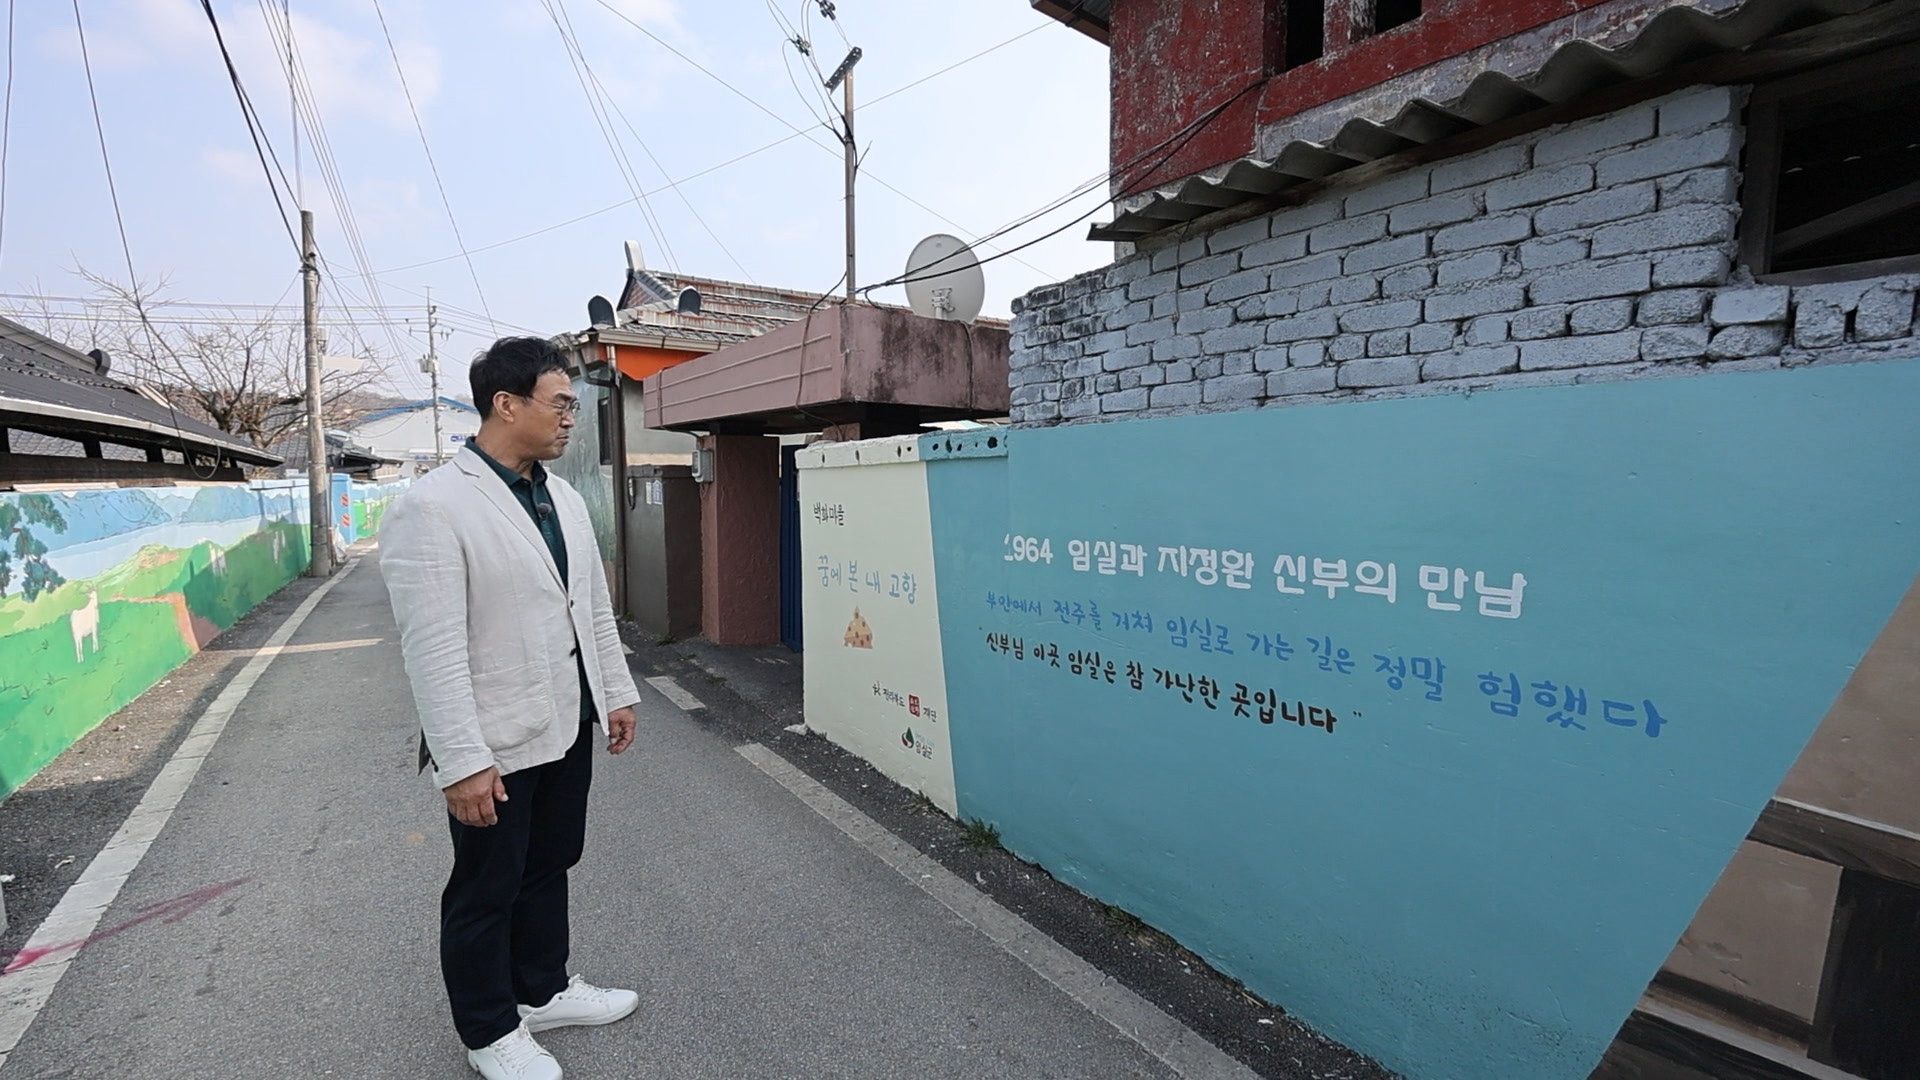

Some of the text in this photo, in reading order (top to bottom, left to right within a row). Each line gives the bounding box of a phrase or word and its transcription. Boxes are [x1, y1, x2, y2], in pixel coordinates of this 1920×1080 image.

[813, 502, 845, 527] 벽화마을
[817, 555, 917, 605] 꿈에 본 내 고향
[1067, 539, 1148, 577] 임실과
[1157, 545, 1255, 590] 지정환
[1273, 555, 1397, 604] 신부의
[1418, 564, 1528, 619] 만남
[986, 591, 1042, 616] 부안에서
[1053, 600, 1102, 631] 전주를
[1166, 616, 1234, 655] 임실로
[1246, 633, 1295, 661] 가는
[1306, 636, 1356, 675] 길은
[1373, 654, 1446, 702] 정말
[1477, 671, 1668, 738] 험했다
[1033, 643, 1060, 668] 이곳
[1068, 650, 1117, 684] 임실은
[1126, 660, 1144, 690] 참
[1152, 667, 1221, 710] 가난한
